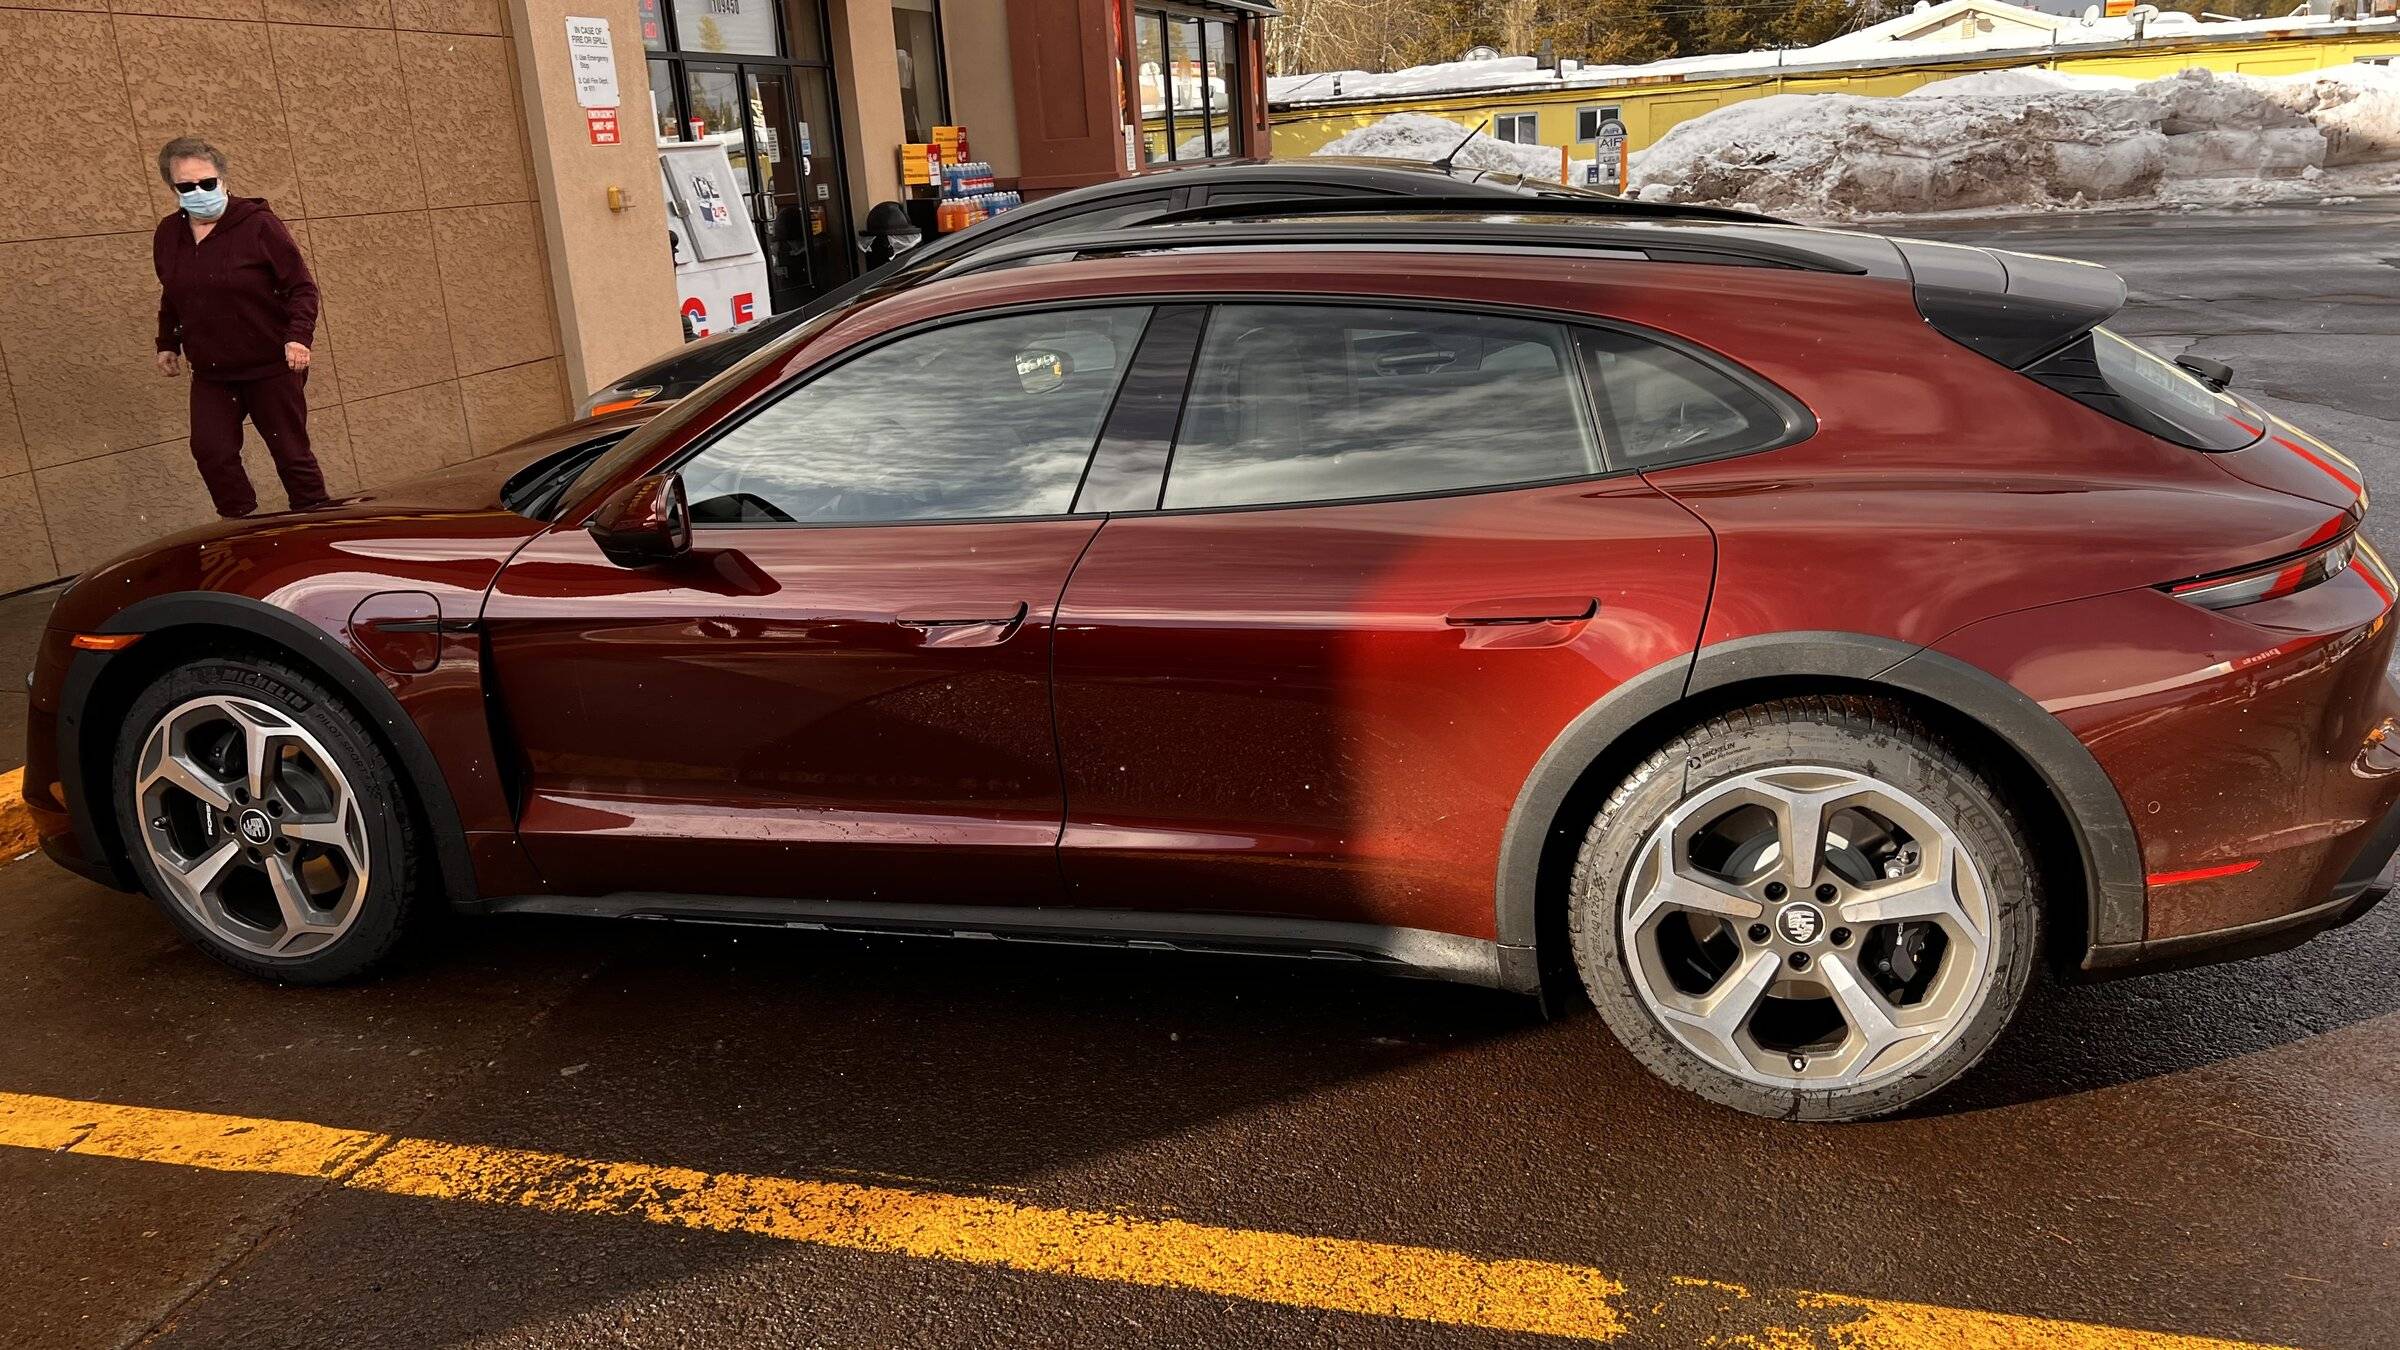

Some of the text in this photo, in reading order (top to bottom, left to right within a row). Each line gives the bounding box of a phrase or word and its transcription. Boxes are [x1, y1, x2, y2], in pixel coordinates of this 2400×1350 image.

[580, 26, 594, 35] CASE
[571, 35, 583, 43] FIRE
[593, 36, 607, 45] SPILL
[222, 669, 308, 709] MICHELIN
